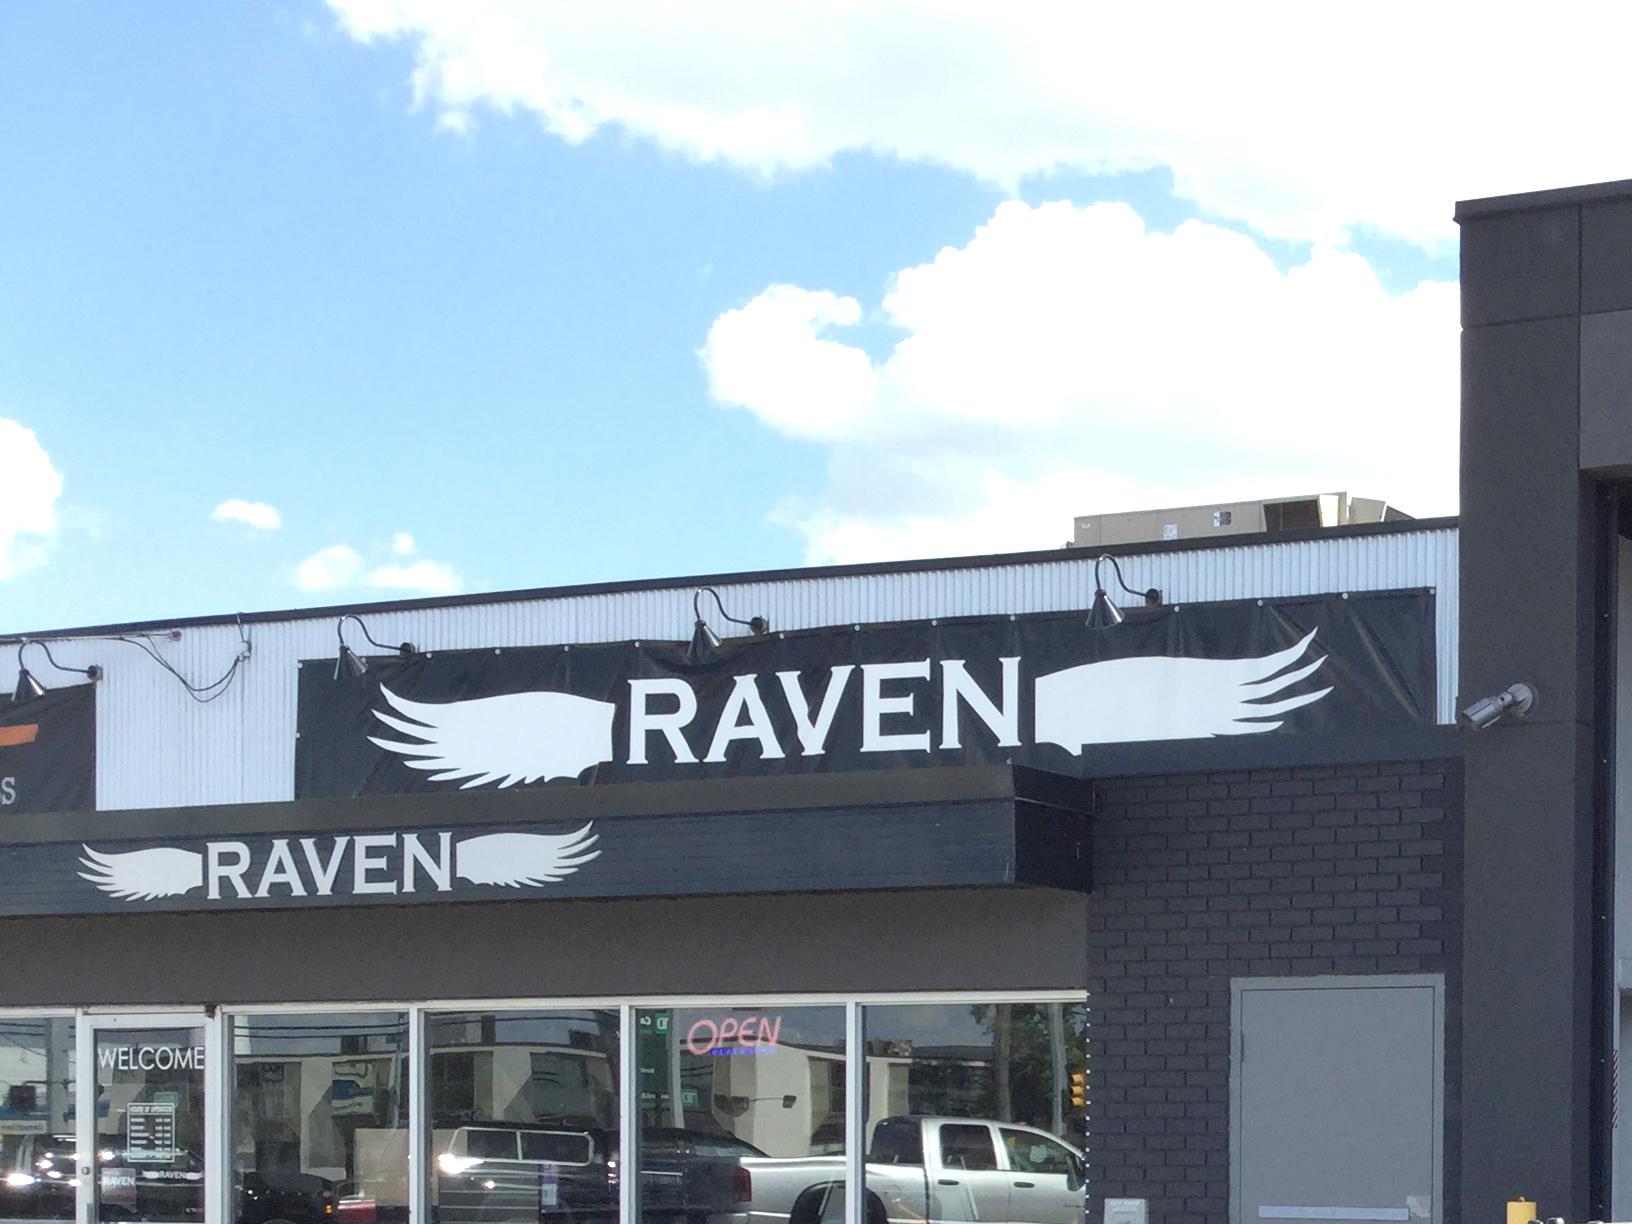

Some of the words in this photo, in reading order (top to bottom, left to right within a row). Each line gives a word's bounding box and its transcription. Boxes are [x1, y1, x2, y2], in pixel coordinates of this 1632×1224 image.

[626, 656, 1021, 765] RAVEN
[206, 831, 452, 900] RAVEN
[686, 1015, 782, 1055] OPEN
[97, 1046, 205, 1070] WELCOME
[159, 1170, 185, 1179] RAVEN
